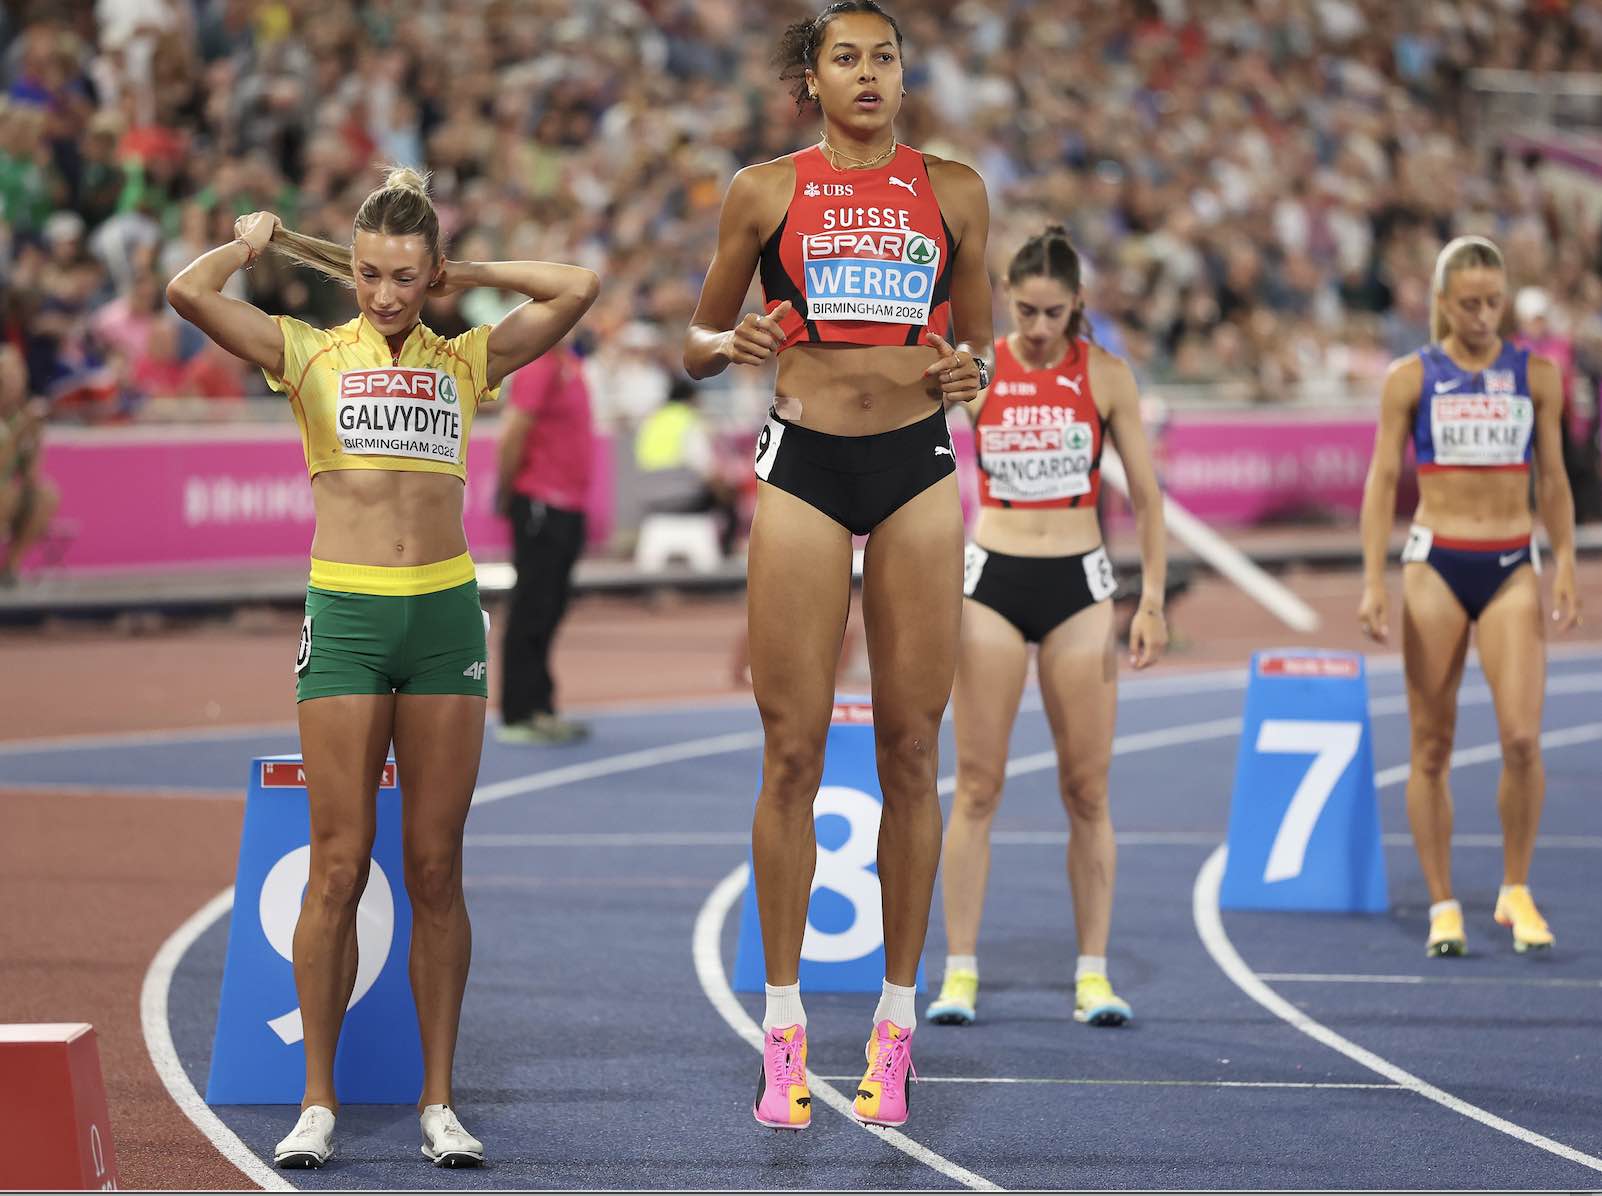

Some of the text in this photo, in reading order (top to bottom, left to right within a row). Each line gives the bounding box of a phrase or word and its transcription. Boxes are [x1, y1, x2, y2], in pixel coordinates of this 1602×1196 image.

[822, 184, 854, 196] UBS
[809, 234, 902, 257] SPAR
[808, 266, 928, 299] WERRO
[813, 302, 924, 319] BIRMINGHAM 2026
[343, 373, 433, 397] SPAR
[339, 404, 459, 440] GALVYDYTE
[756, 424, 771, 464] 9
[985, 431, 1060, 451] SPAR
[1442, 425, 1519, 446] REEKIE
[343, 438, 455, 458] BIRMINGHAM 2026
[1256, 719, 1363, 883] 7
[800, 785, 884, 963] 8
[259, 844, 395, 1046] 9
